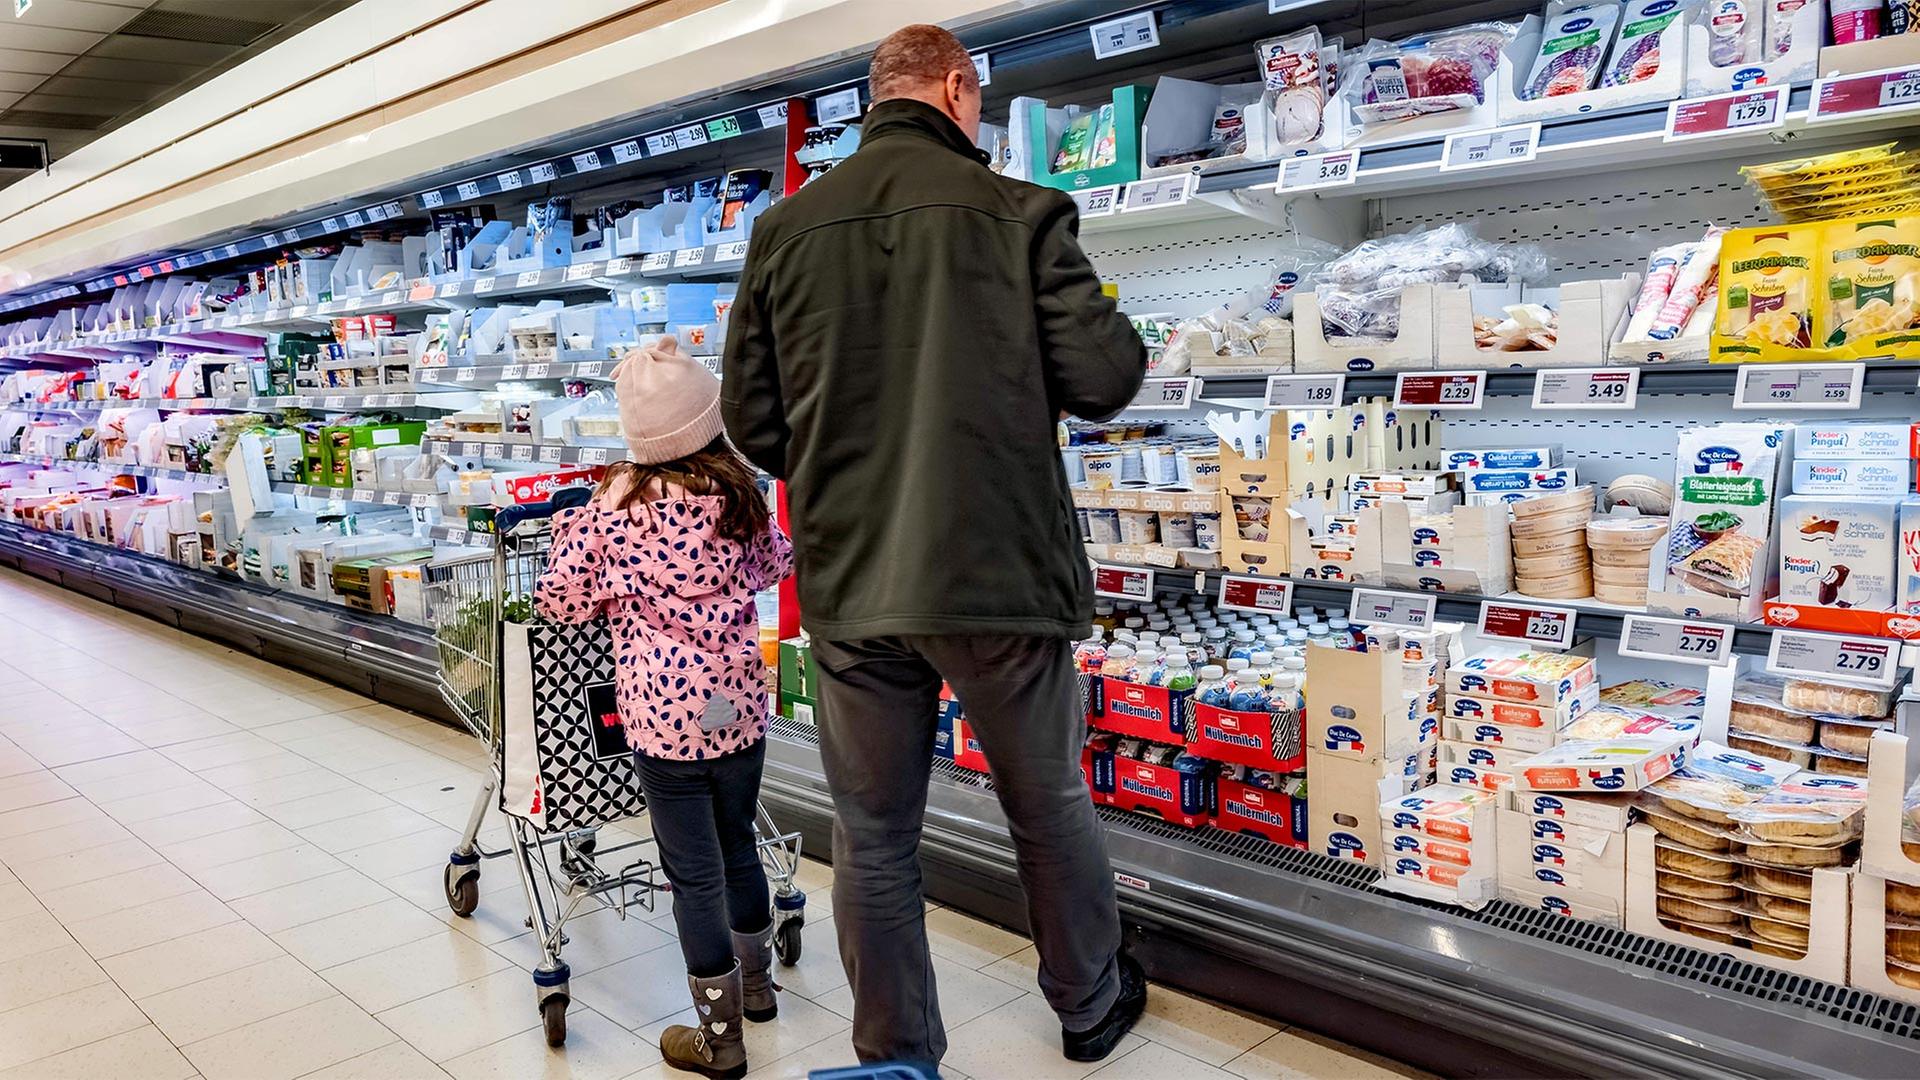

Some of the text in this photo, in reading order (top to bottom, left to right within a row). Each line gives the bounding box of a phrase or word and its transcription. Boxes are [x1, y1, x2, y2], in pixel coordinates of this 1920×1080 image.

[1378, 83, 1406, 95] BUFFET
[1735, 104, 1767, 121] 1.79
[721, 117, 738, 134] 3.79
[688, 126, 705, 142] 2.99
[1319, 162, 1348, 179] 3.49
[1088, 196, 1110, 211] 2.22
[1732, 256, 1809, 274] LEERDAMMER
[1855, 273, 1895, 284] Scheiben
[1750, 282, 1787, 294] Scheiben
[1161, 388, 1184, 402] 1.79
[1305, 386, 1333, 401] 1.89
[1443, 385, 1471, 401] 2.29
[1588, 383, 1625, 398] 3.49
[1770, 389, 1792, 399] 4.99
[1824, 388, 1845, 399] 2.59
[1700, 451, 1712, 460] Duc
[1720, 453, 1738, 461] Coeur
[1088, 459, 1112, 472] alpro
[1195, 462, 1220, 476] alpro
[1108, 494, 1138, 509] alpro
[1143, 495, 1173, 511] alpro
[1181, 496, 1213, 512] alpro
[1170, 517, 1188, 527] alpro
[1849, 522, 1879, 532] Milch-
[1843, 530, 1885, 540] Schnitte
[1114, 548, 1144, 564] alpro
[1145, 549, 1175, 566] alpro
[1407, 614, 1424, 624] 2.69
[1530, 622, 1559, 637] 2.29
[1679, 636, 1718, 653] 2.79
[1836, 652, 1881, 672] 2.79
[1111, 700, 1162, 721] Müllermilch
[1204, 725, 1263, 749] Müllermilch
[1329, 728, 1339, 736] Duc
[1346, 732, 1360, 741] Coeur
[1121, 777, 1174, 803] Müllermilch
[1226, 799, 1284, 828] Müllermilch
[1348, 840, 1361, 849] Coeur
